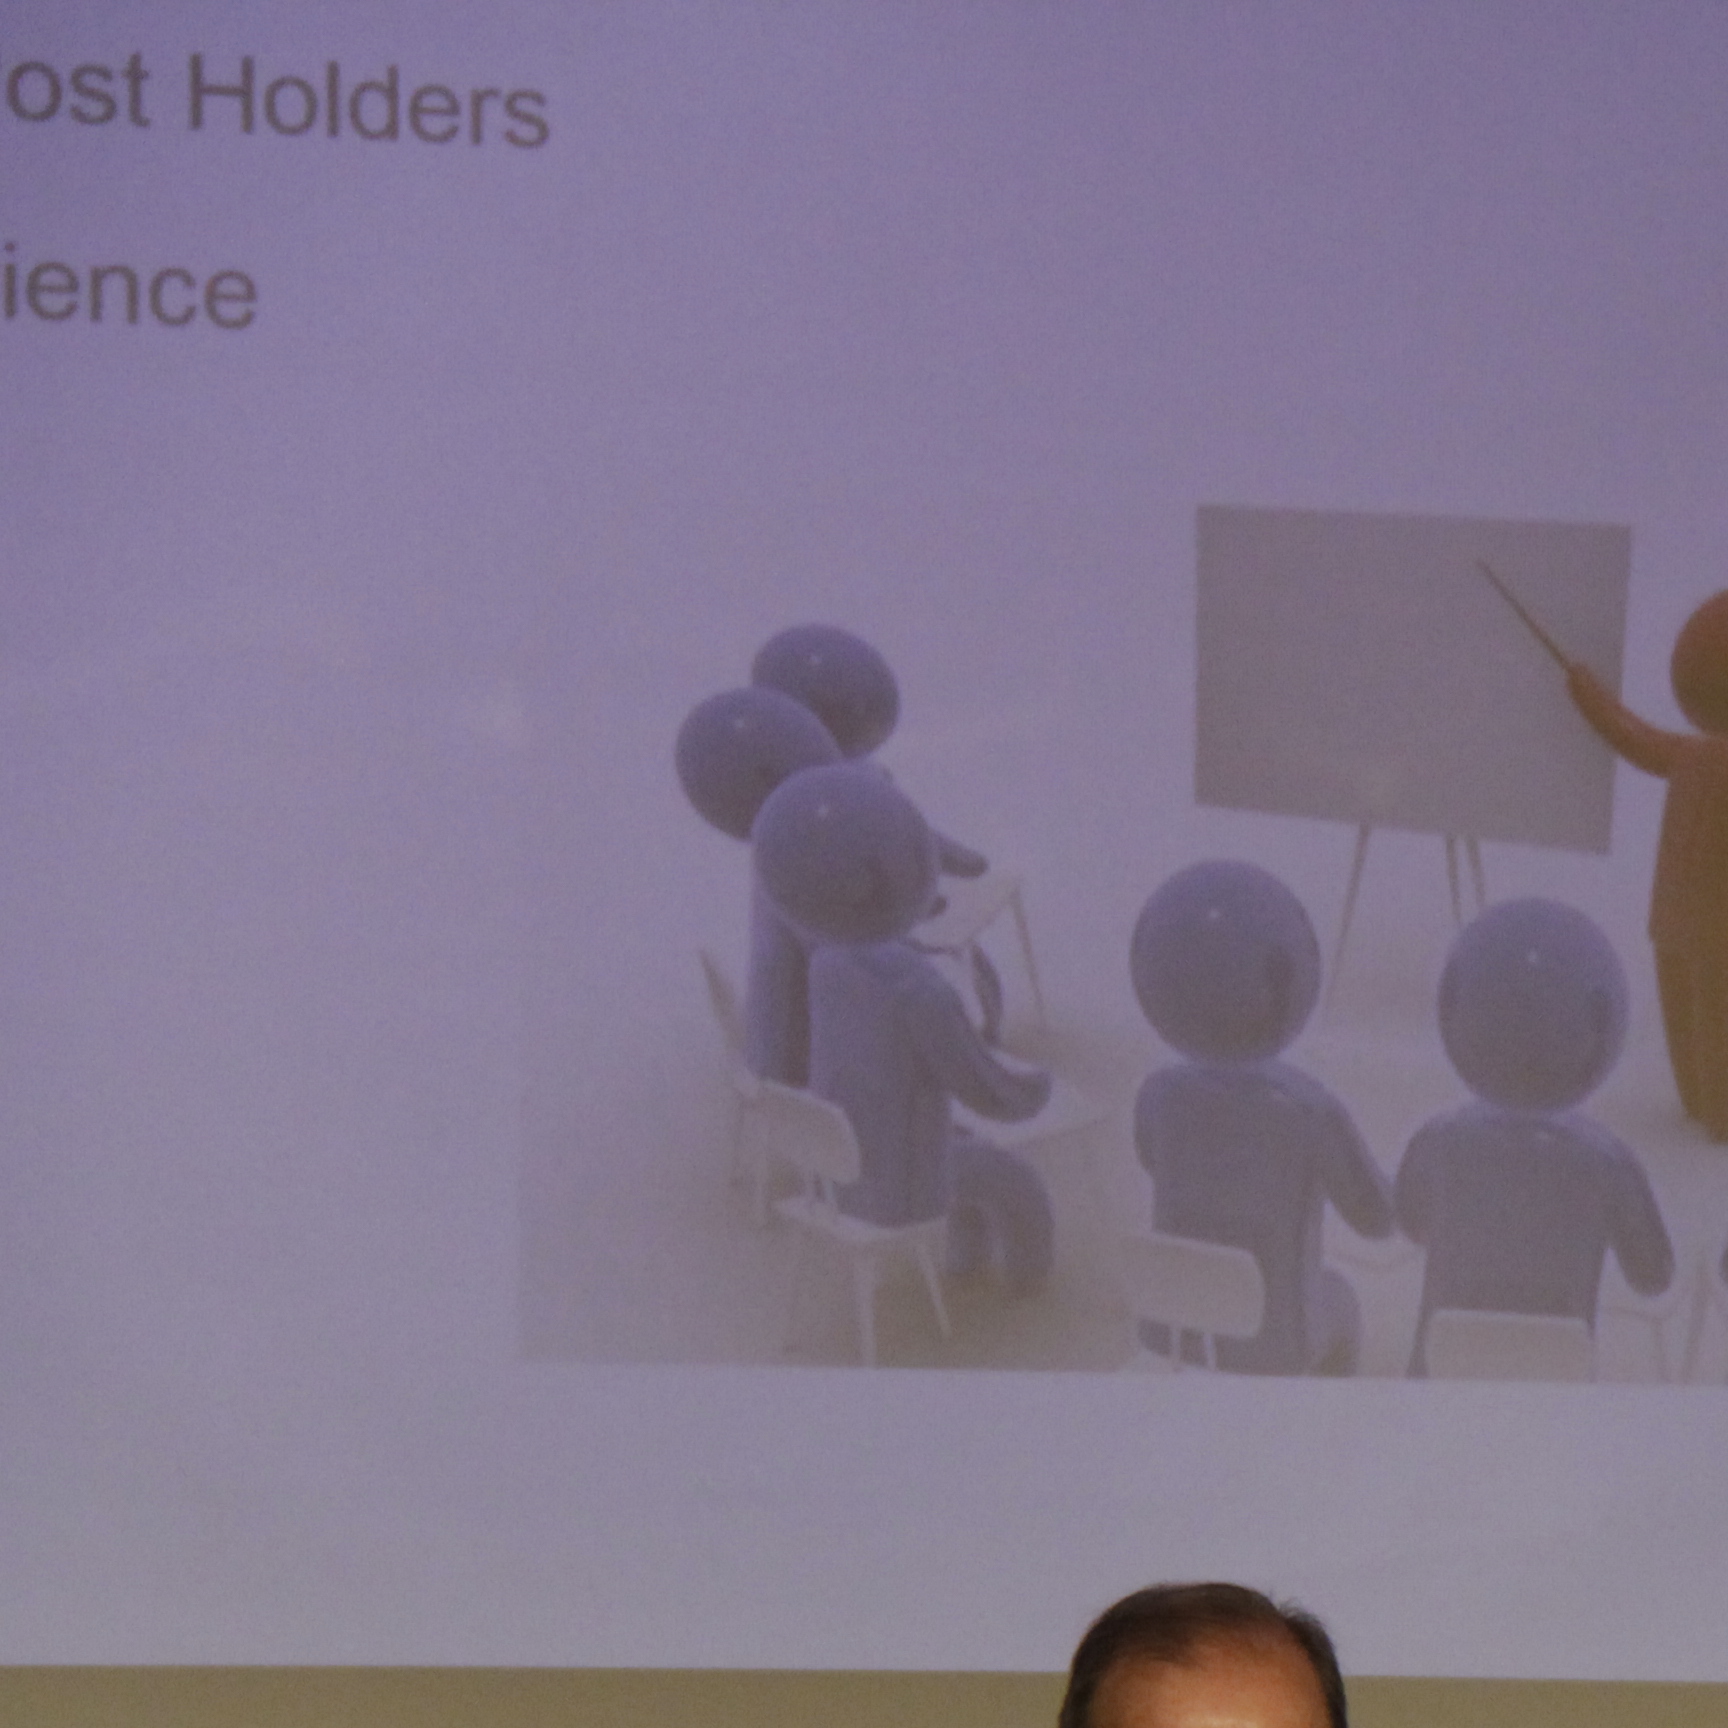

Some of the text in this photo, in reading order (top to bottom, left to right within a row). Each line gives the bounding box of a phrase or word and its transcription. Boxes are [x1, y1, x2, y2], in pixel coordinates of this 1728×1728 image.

[7, 51, 550, 149] ost Holders
[2, 242, 258, 330] ience
